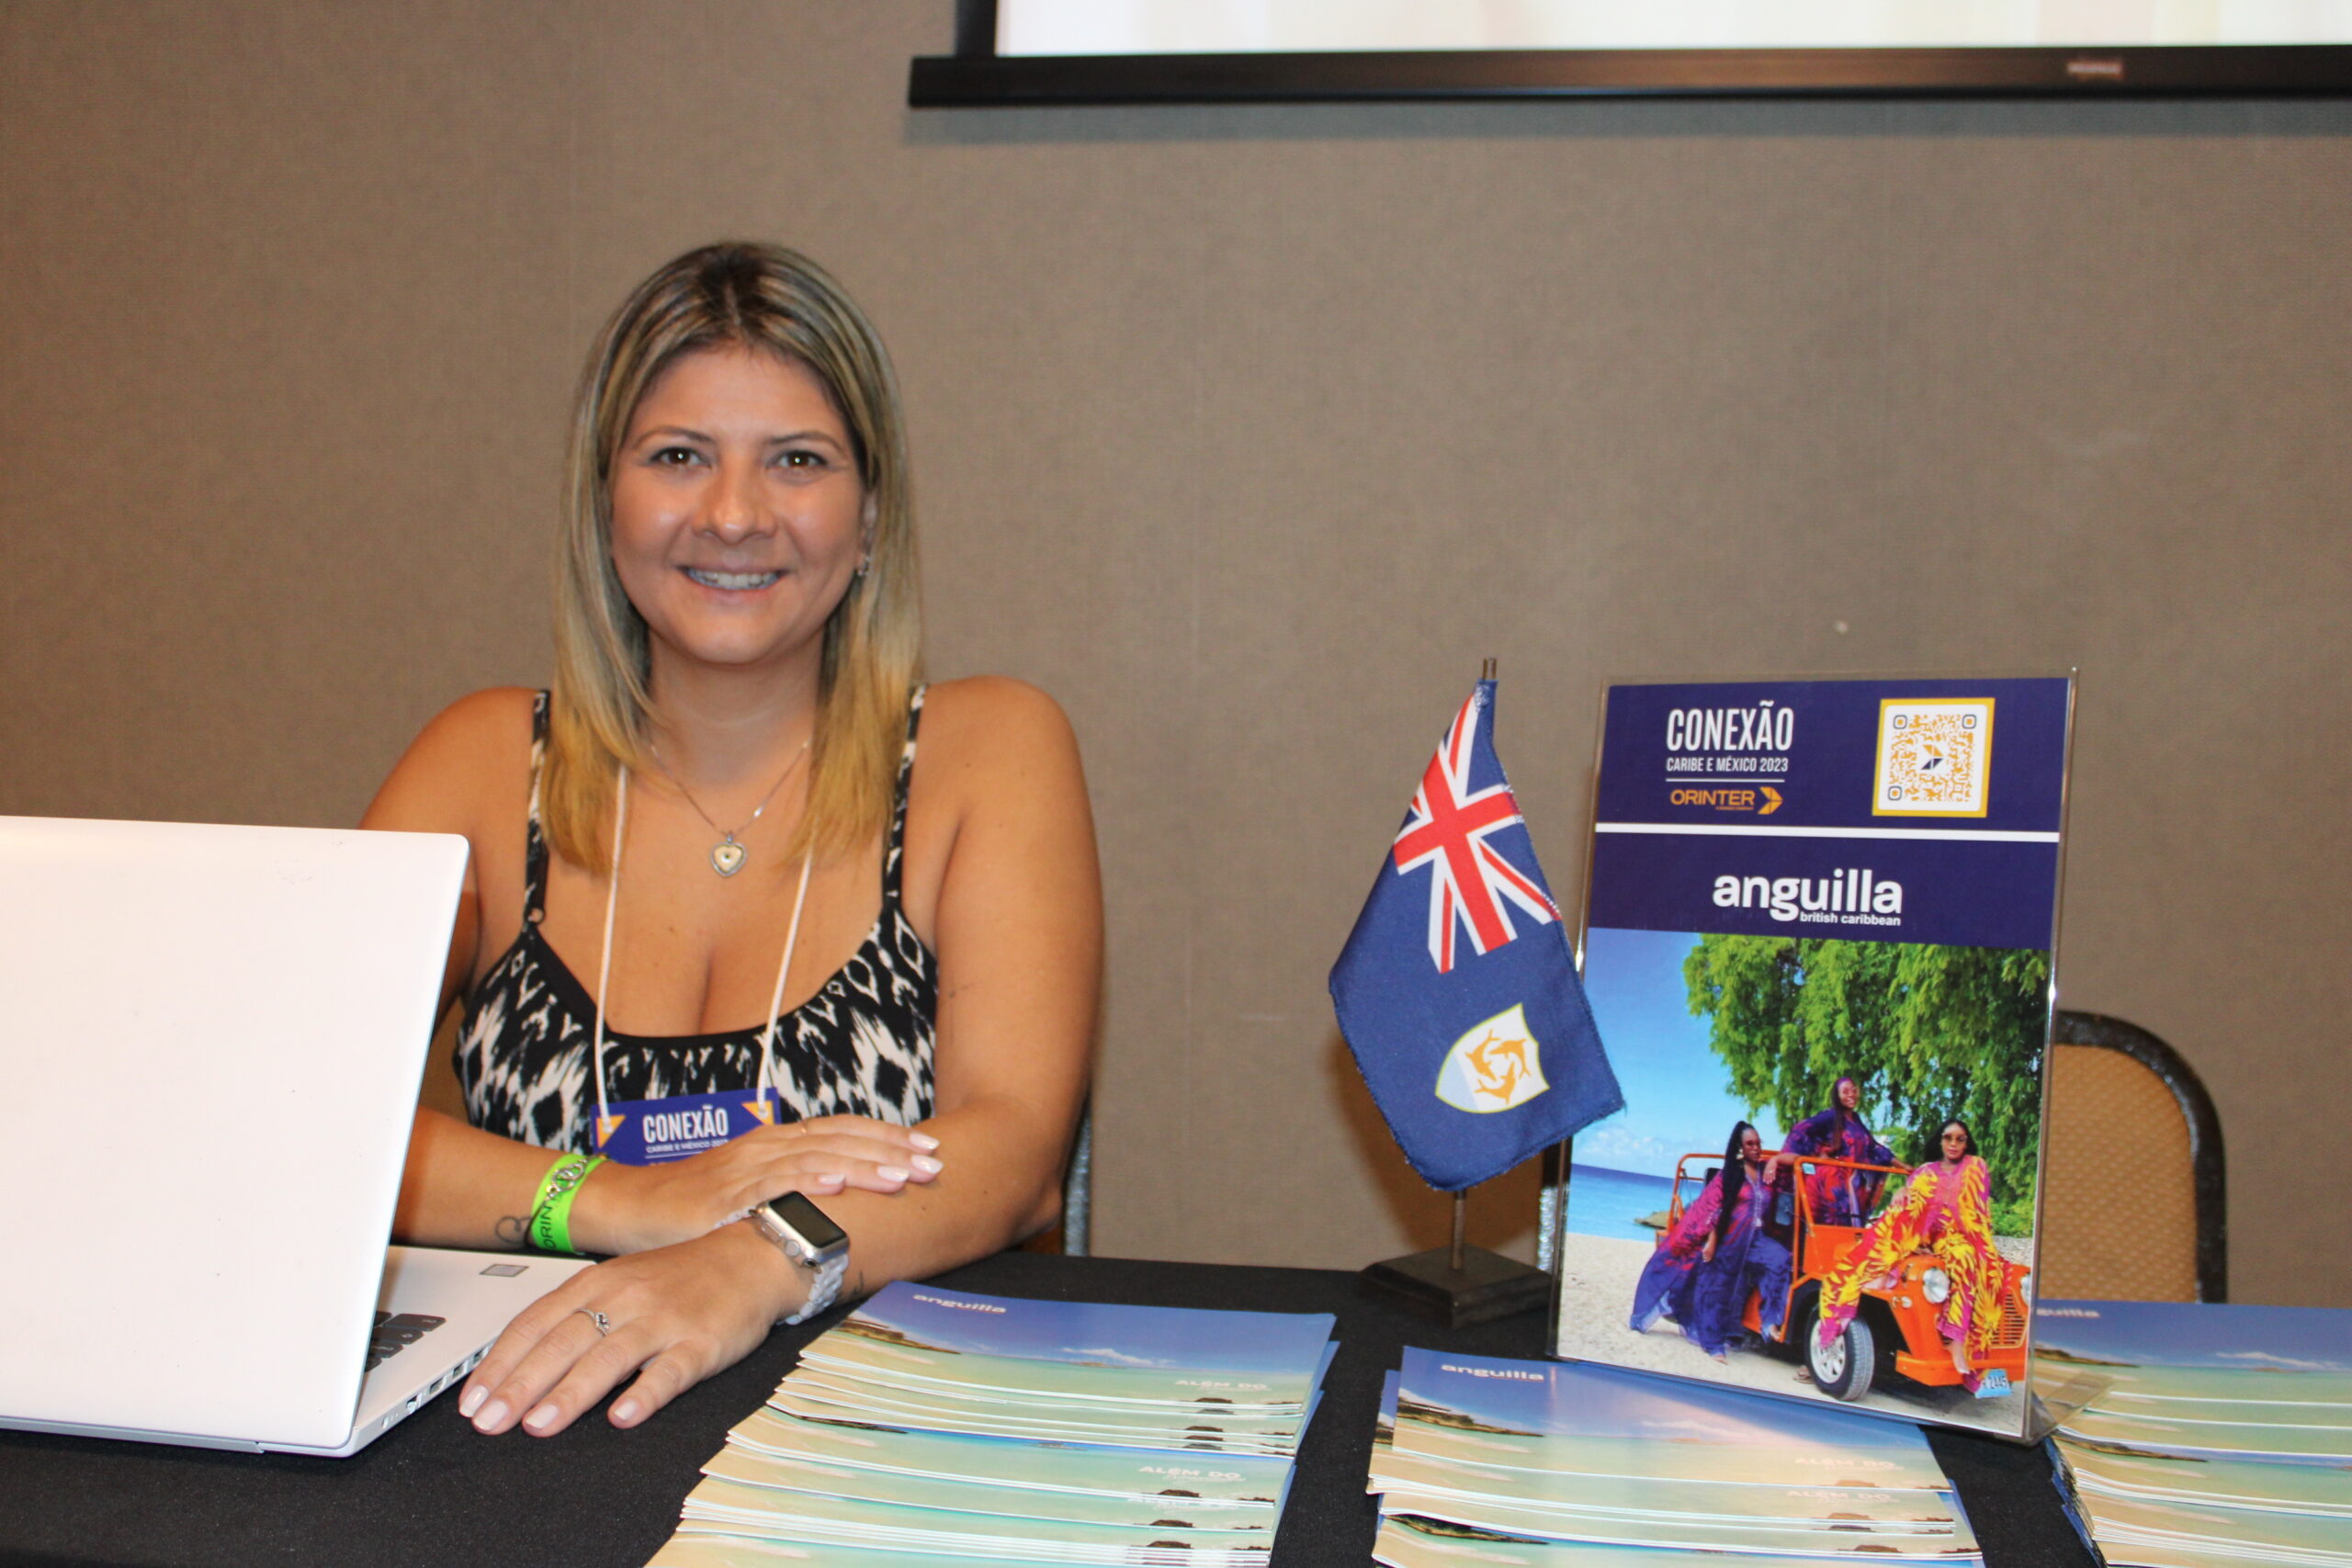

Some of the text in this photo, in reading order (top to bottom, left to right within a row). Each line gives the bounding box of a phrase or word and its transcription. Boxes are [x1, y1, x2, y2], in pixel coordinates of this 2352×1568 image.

[1667, 700, 1794, 751] CONEXÃO
[1667, 755, 1789, 772] CARIBE E MÉXICO 2023
[1670, 789, 1755, 806] ORINTER
[1713, 868, 1903, 921] anguilla
[1800, 911, 1901, 926] british caribbean
[643, 1104, 729, 1143] CONEXÃO
[912, 1294, 1007, 1314] anguilla
[1441, 1365, 1544, 1382] anguilla
